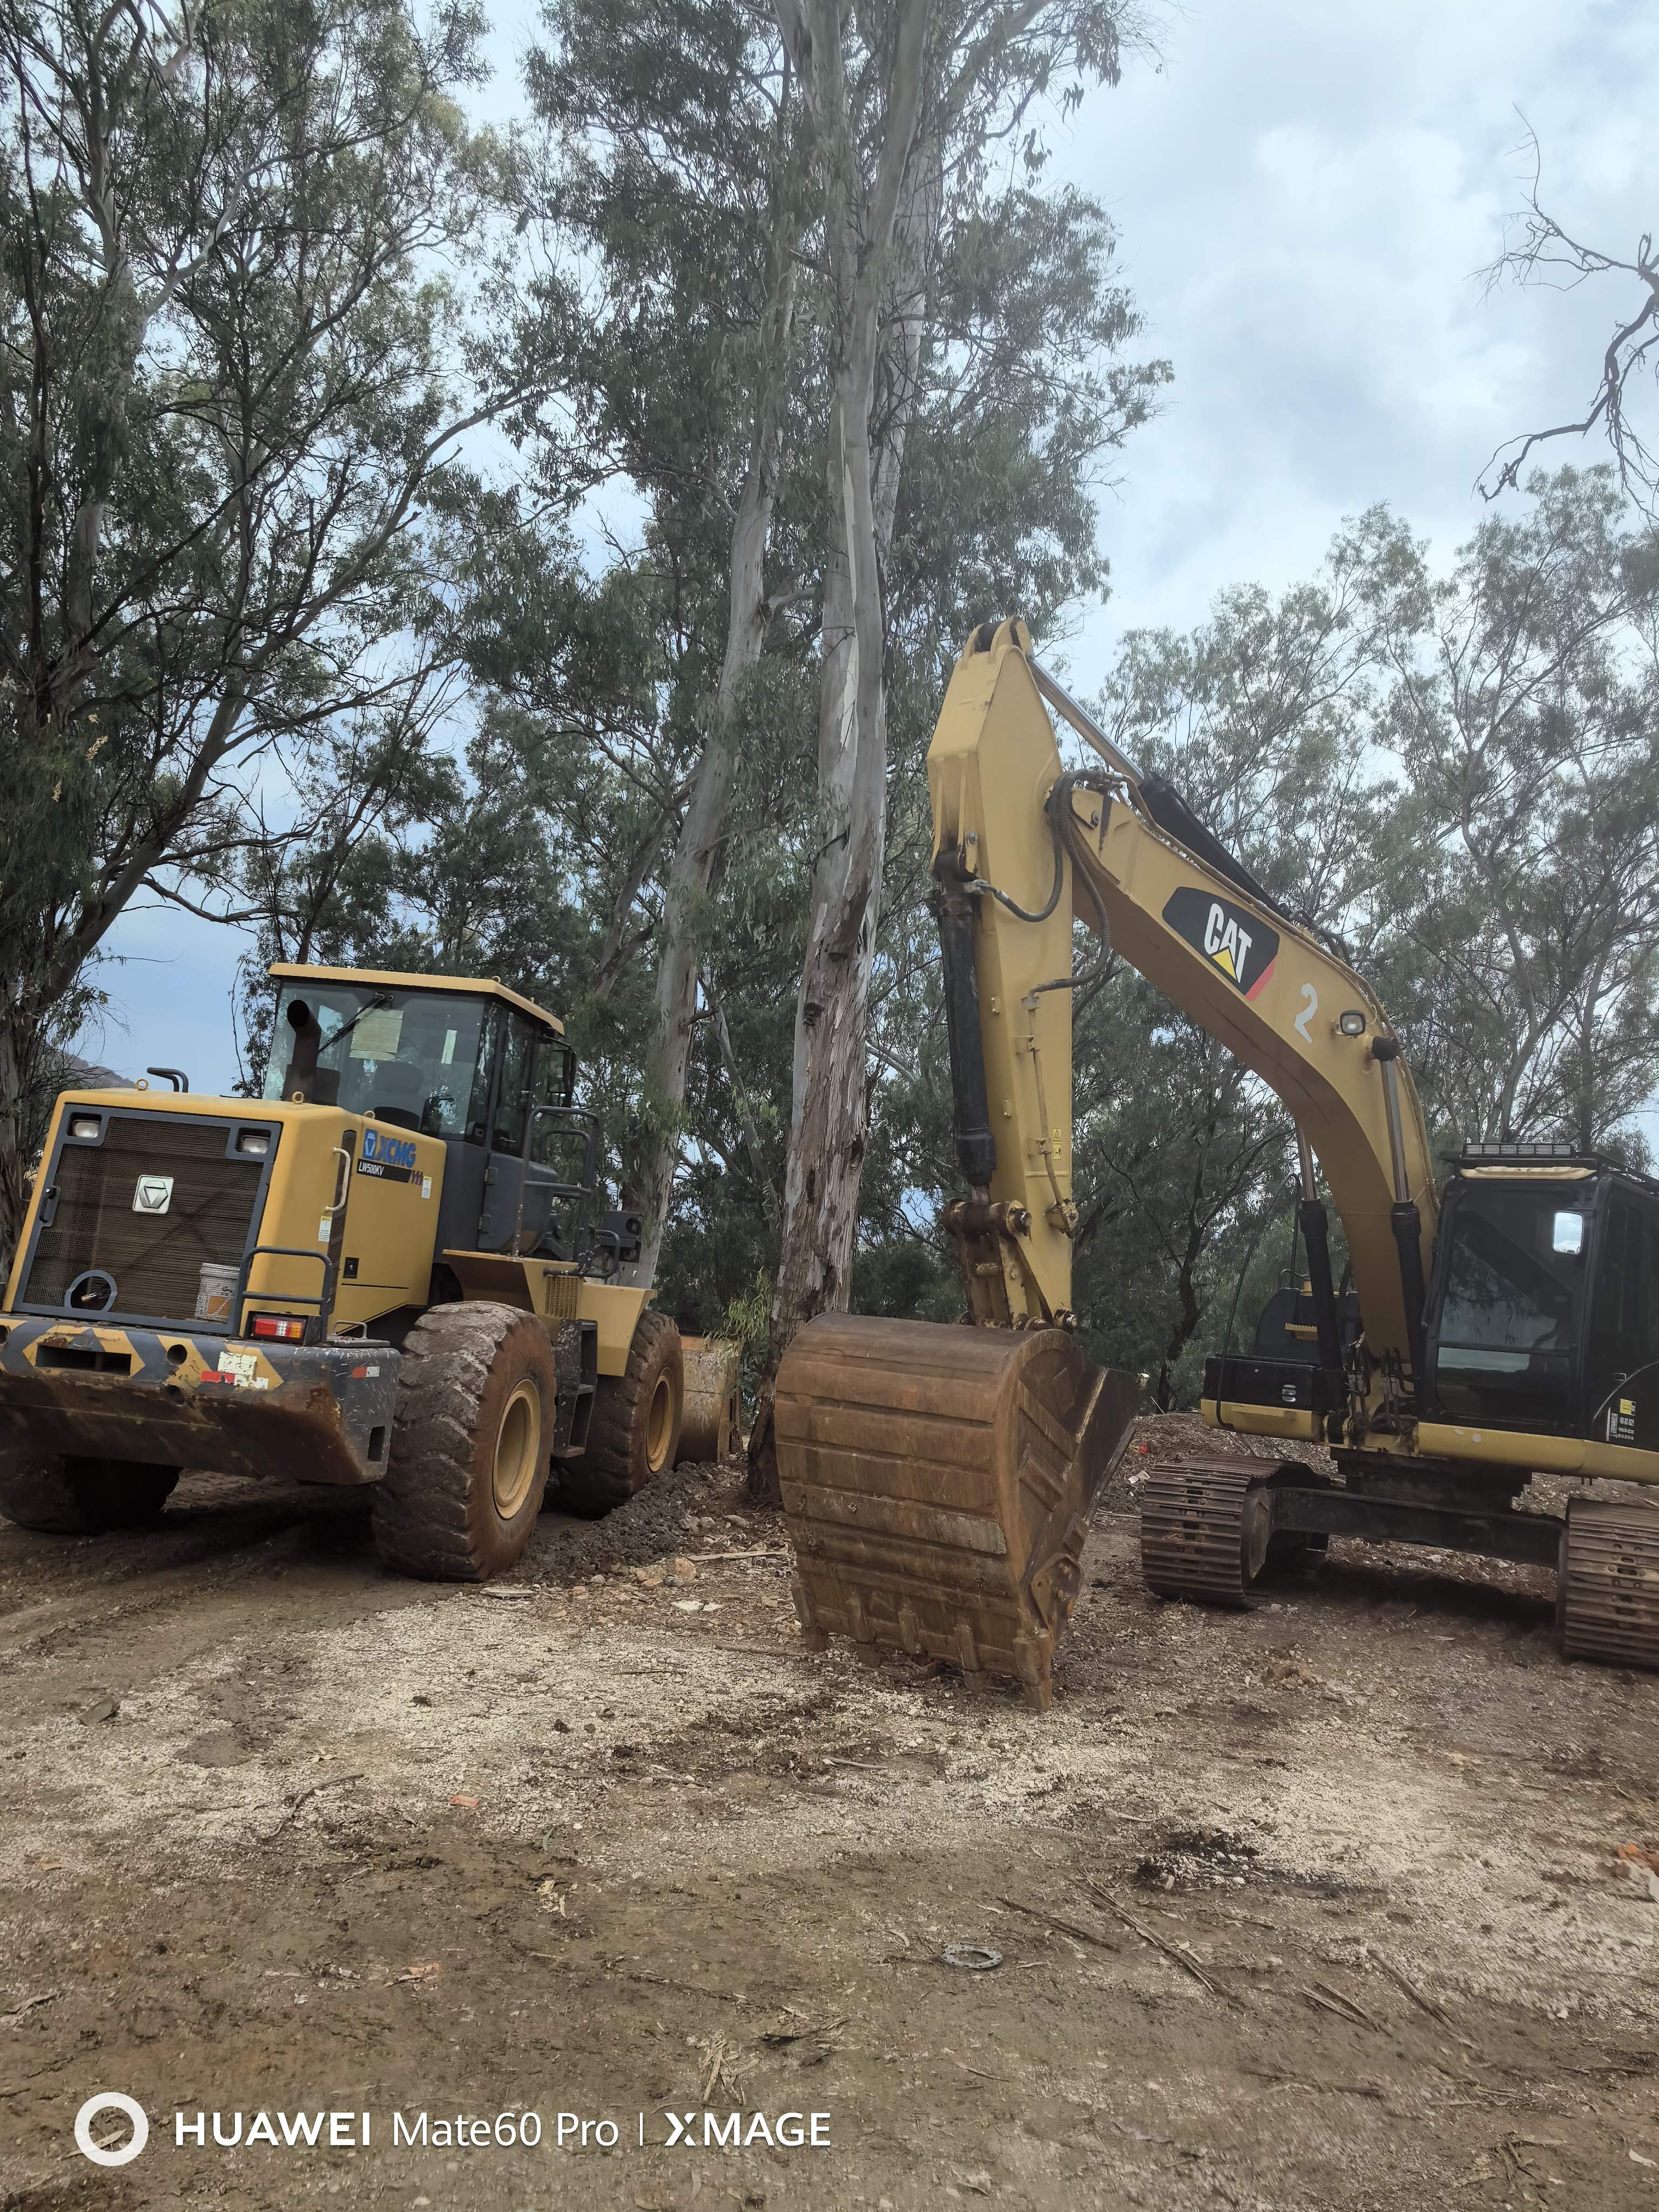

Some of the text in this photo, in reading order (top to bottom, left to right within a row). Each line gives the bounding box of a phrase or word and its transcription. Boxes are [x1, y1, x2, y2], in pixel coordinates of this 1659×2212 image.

[1204, 903, 1252, 983] CAT
[1294, 982, 1318, 1043] 2
[375, 1135, 416, 1168] XCMG
